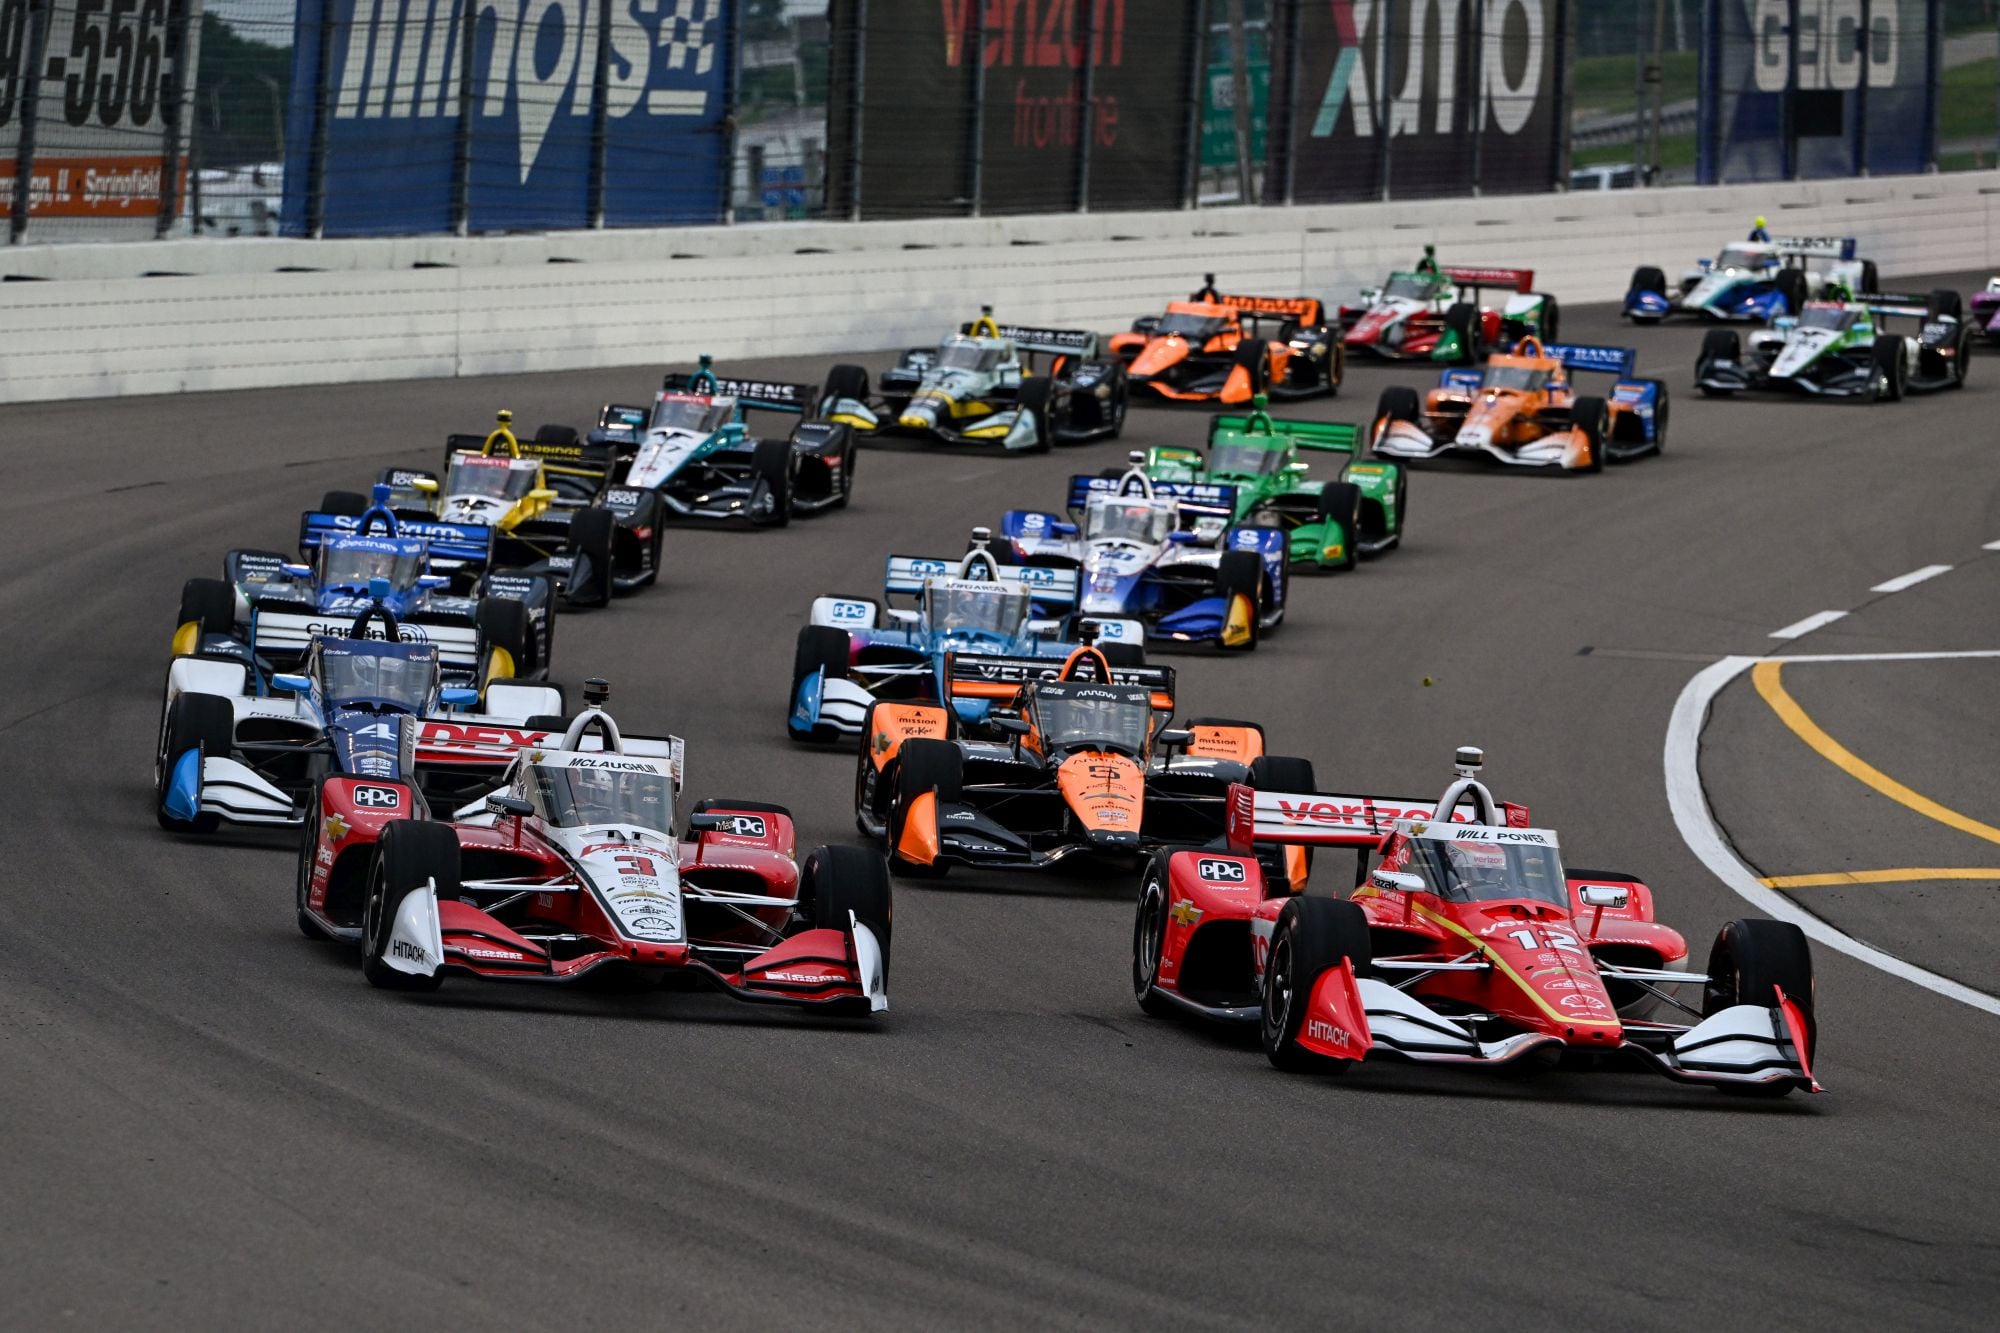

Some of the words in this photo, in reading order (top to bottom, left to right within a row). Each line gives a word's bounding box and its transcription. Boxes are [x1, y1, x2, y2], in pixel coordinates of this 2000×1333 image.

[1755, 0, 1899, 92] GEICO
[334, 515, 461, 542] Spetrum
[833, 604, 865, 618] PPG
[1101, 622, 1123, 638] PG
[899, 717, 937, 725] mission
[355, 723, 398, 741] 4
[418, 722, 549, 753] DEX
[1089, 765, 1121, 779] 5
[356, 788, 396, 806] PPG
[734, 817, 764, 835] PG
[1456, 829, 1489, 839] WILL
[1496, 832, 1549, 845] POWER
[614, 855, 658, 877] 3
[1201, 862, 1244, 880] PPG
[1507, 929, 1584, 956] 12
[1308, 1019, 1350, 1050] HITACHI
